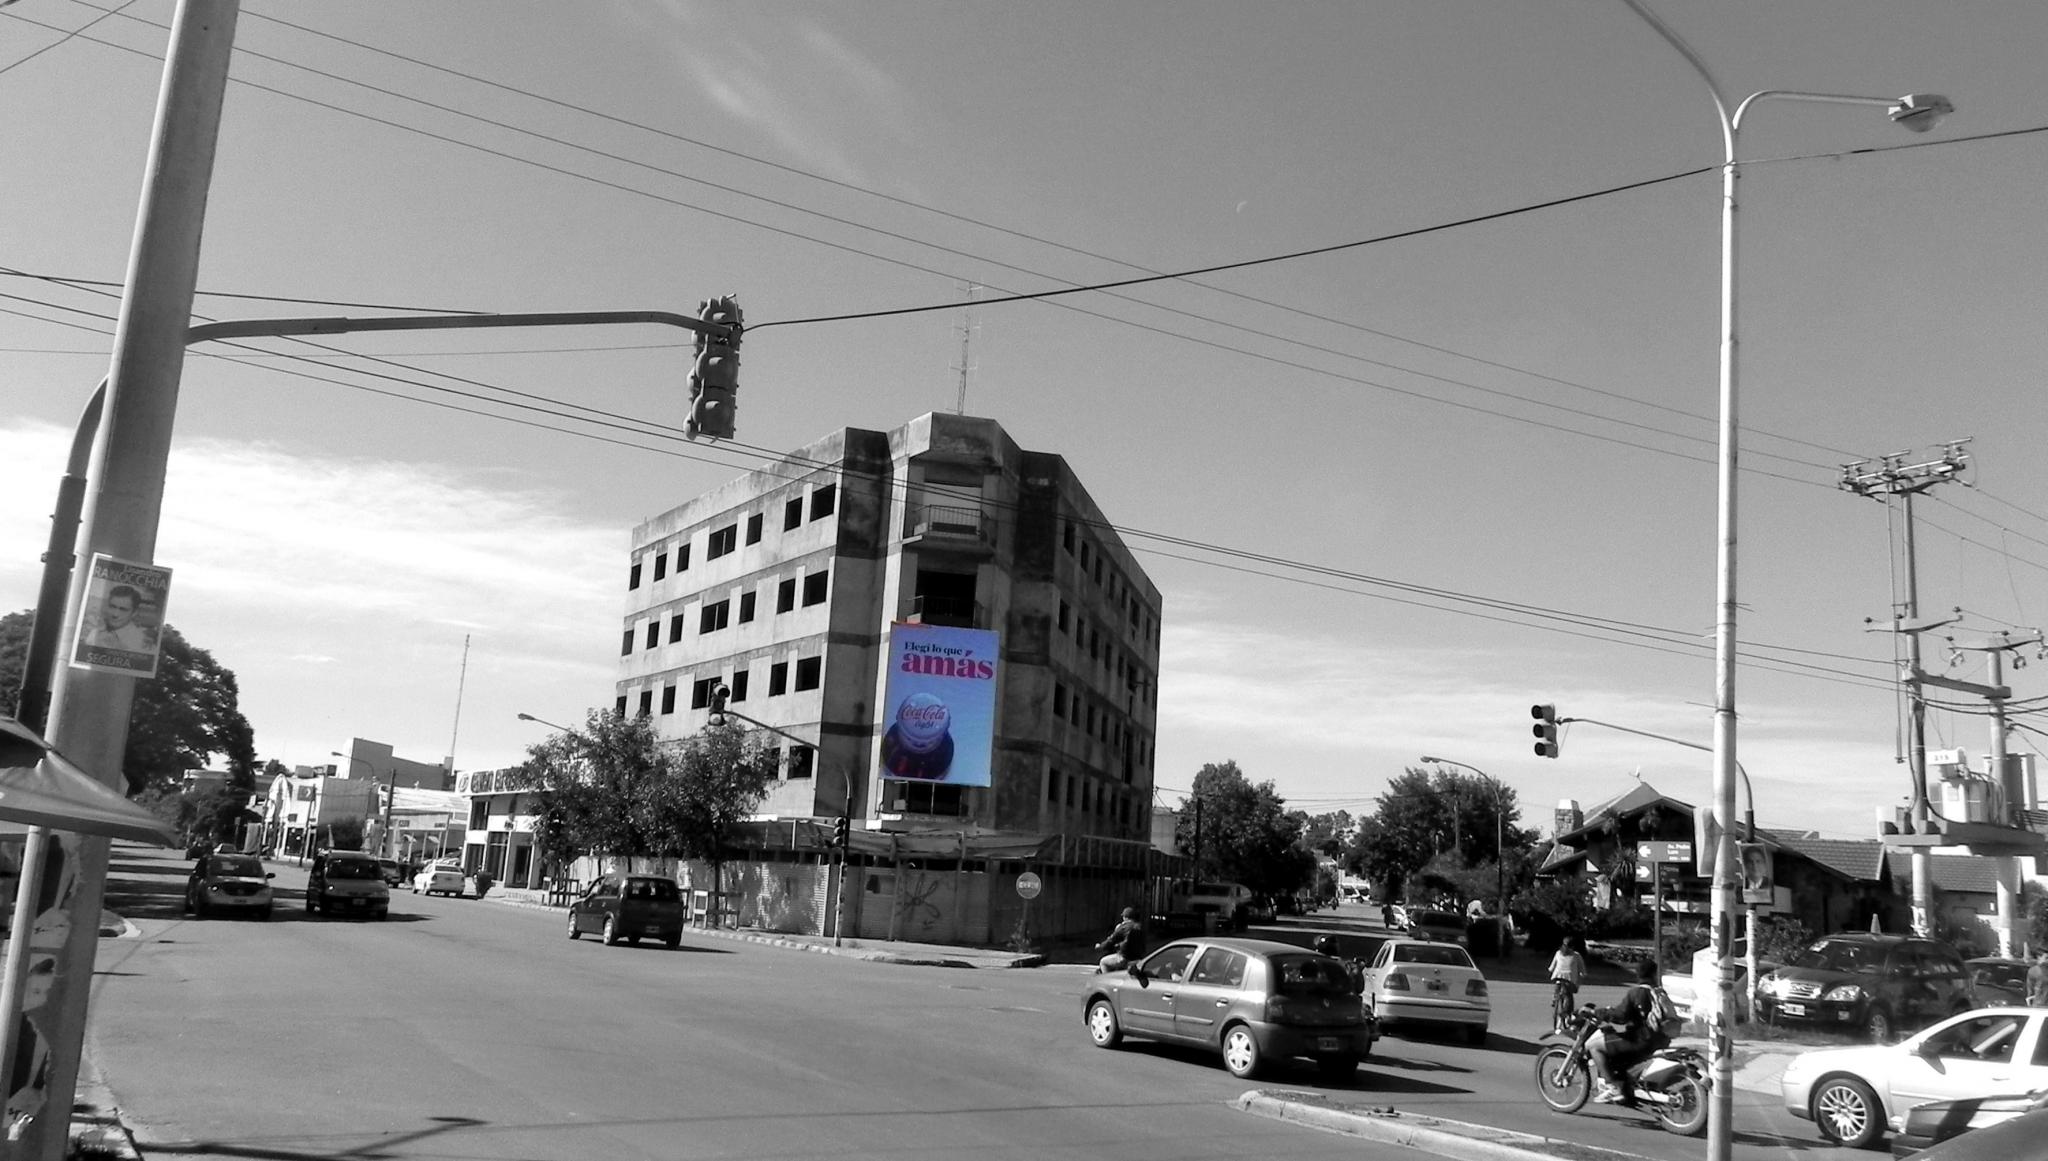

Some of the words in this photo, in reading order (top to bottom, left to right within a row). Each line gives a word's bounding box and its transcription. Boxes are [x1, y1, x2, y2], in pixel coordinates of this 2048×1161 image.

[95, 565, 168, 590] RANOCCHIA
[87, 652, 132, 668] SEGURA
[932, 644, 941, 653] lo
[943, 647, 963, 656] que
[901, 650, 993, 680] amás
